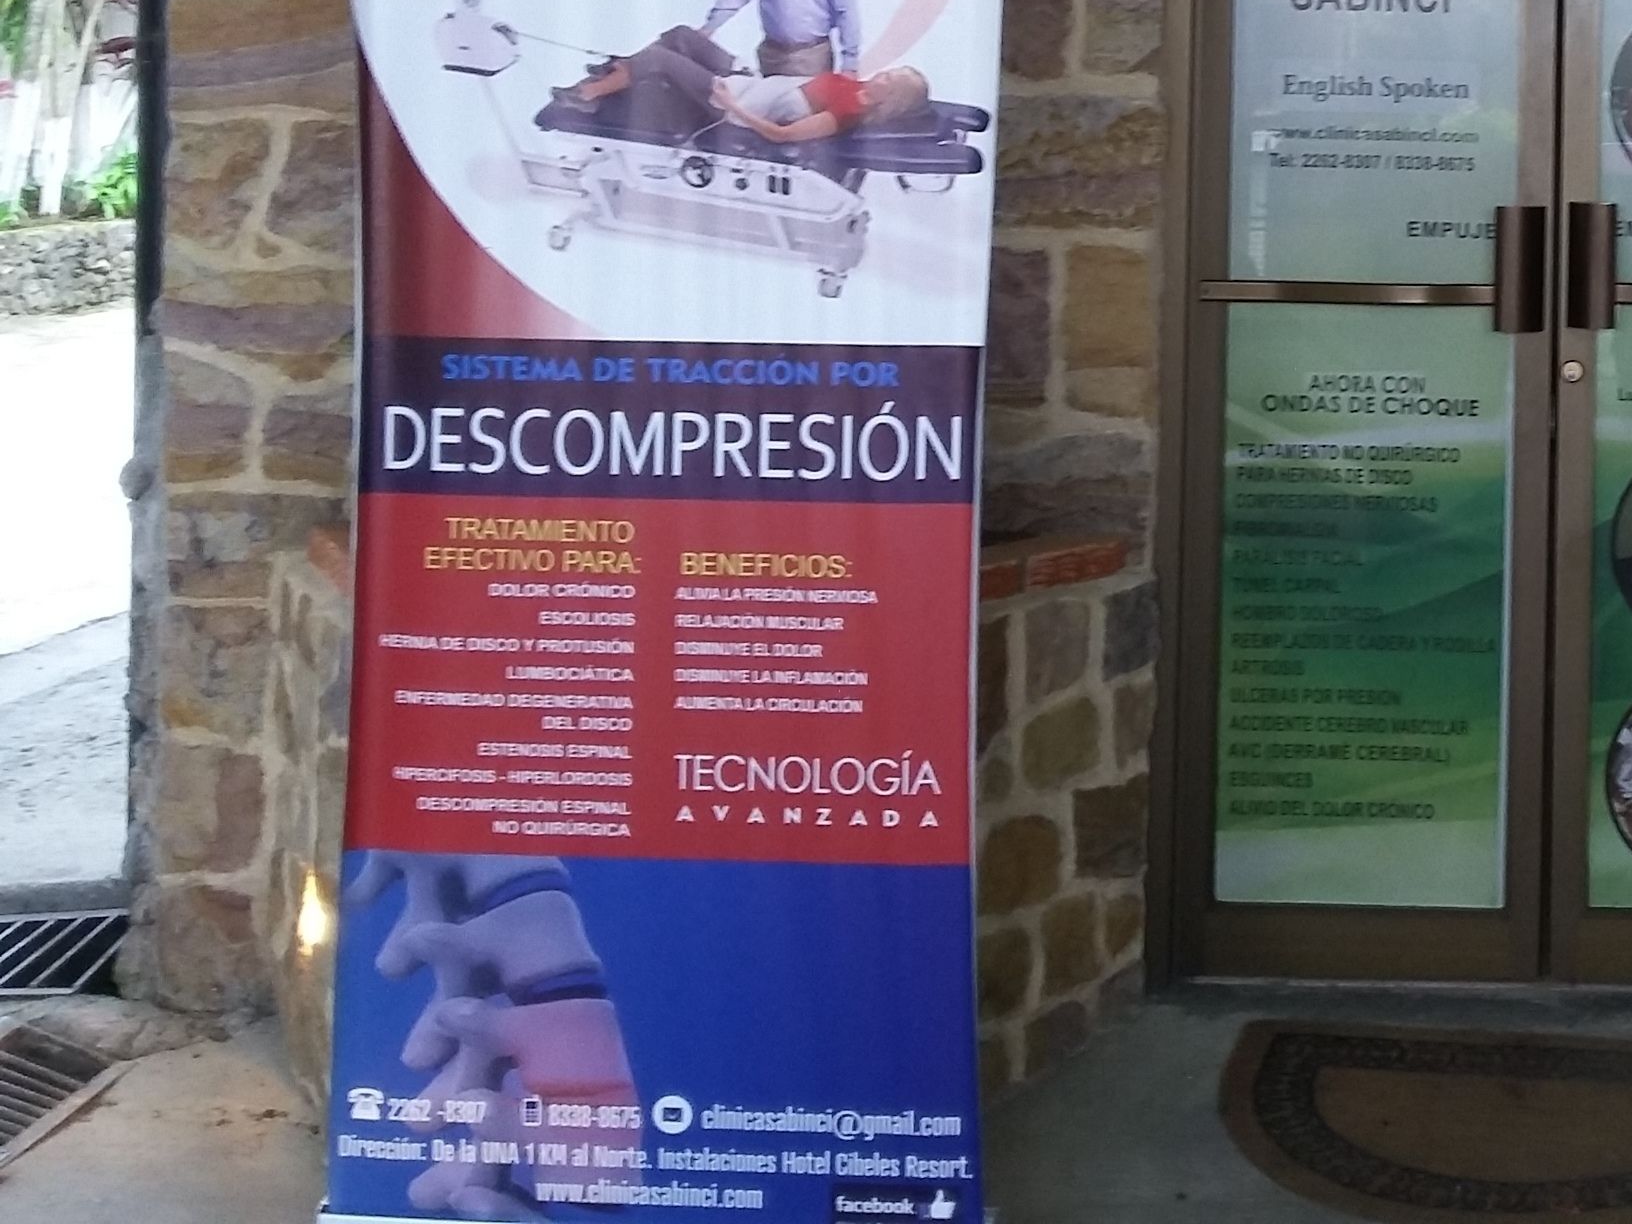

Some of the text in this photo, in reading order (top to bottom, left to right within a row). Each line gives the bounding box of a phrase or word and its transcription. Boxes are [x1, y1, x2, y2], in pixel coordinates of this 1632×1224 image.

[1284, 73, 1469, 102] English Spoken
[1407, 221, 1497, 239] EMPUJE
[441, 353, 898, 388] SISTEMA DE TRACCIÓN POR
[1308, 374, 1426, 395] AHORA CON
[1261, 393, 1481, 417] ONDAS DE CHOQUE
[382, 401, 964, 481] DESCOMPRESIÓN
[1238, 442, 1339, 461] TRATAMIENTO
[446, 517, 635, 543] TRATAMIENTO
[424, 547, 641, 575] EFECTIVO PARA:
[680, 552, 853, 578] BENEFICIOS:
[488, 581, 636, 599] DOLOR CRÓNICO
[539, 611, 636, 626] ESCOLIOSIS
[440, 637, 465, 650] DE
[467, 637, 520, 652] DISCO
[524, 639, 535, 652] Y
[542, 716, 632, 731] DEL DISCO
[477, 742, 632, 759] ESTENOSIS ESPINAL
[673, 750, 942, 796] TECNOLOGÍA
[561, 800, 631, 815] ESPINAL
[675, 804, 939, 828] AVANZADA
[492, 821, 520, 834] NO
[388, 1097, 432, 1122] 2262
[700, 1103, 962, 1141] clinicasabinci@gmail.com
[337, 1134, 427, 1161] Dirección:
[430, 1138, 455, 1162] De
[459, 1138, 476, 1163] la
[480, 1141, 519, 1165] UNA
[538, 1144, 567, 1166] KM
[570, 1143, 589, 1167] al
[593, 1145, 652, 1170] Norte.
[657, 1147, 777, 1174] Instalaciones
[781, 1150, 830, 1175] Hotel
[834, 1152, 900, 1178] Cibeles
[905, 1155, 973, 1180] Resort.
[536, 1178, 763, 1210] www.clinicasabinci.com
[834, 1195, 918, 1215] facebook
